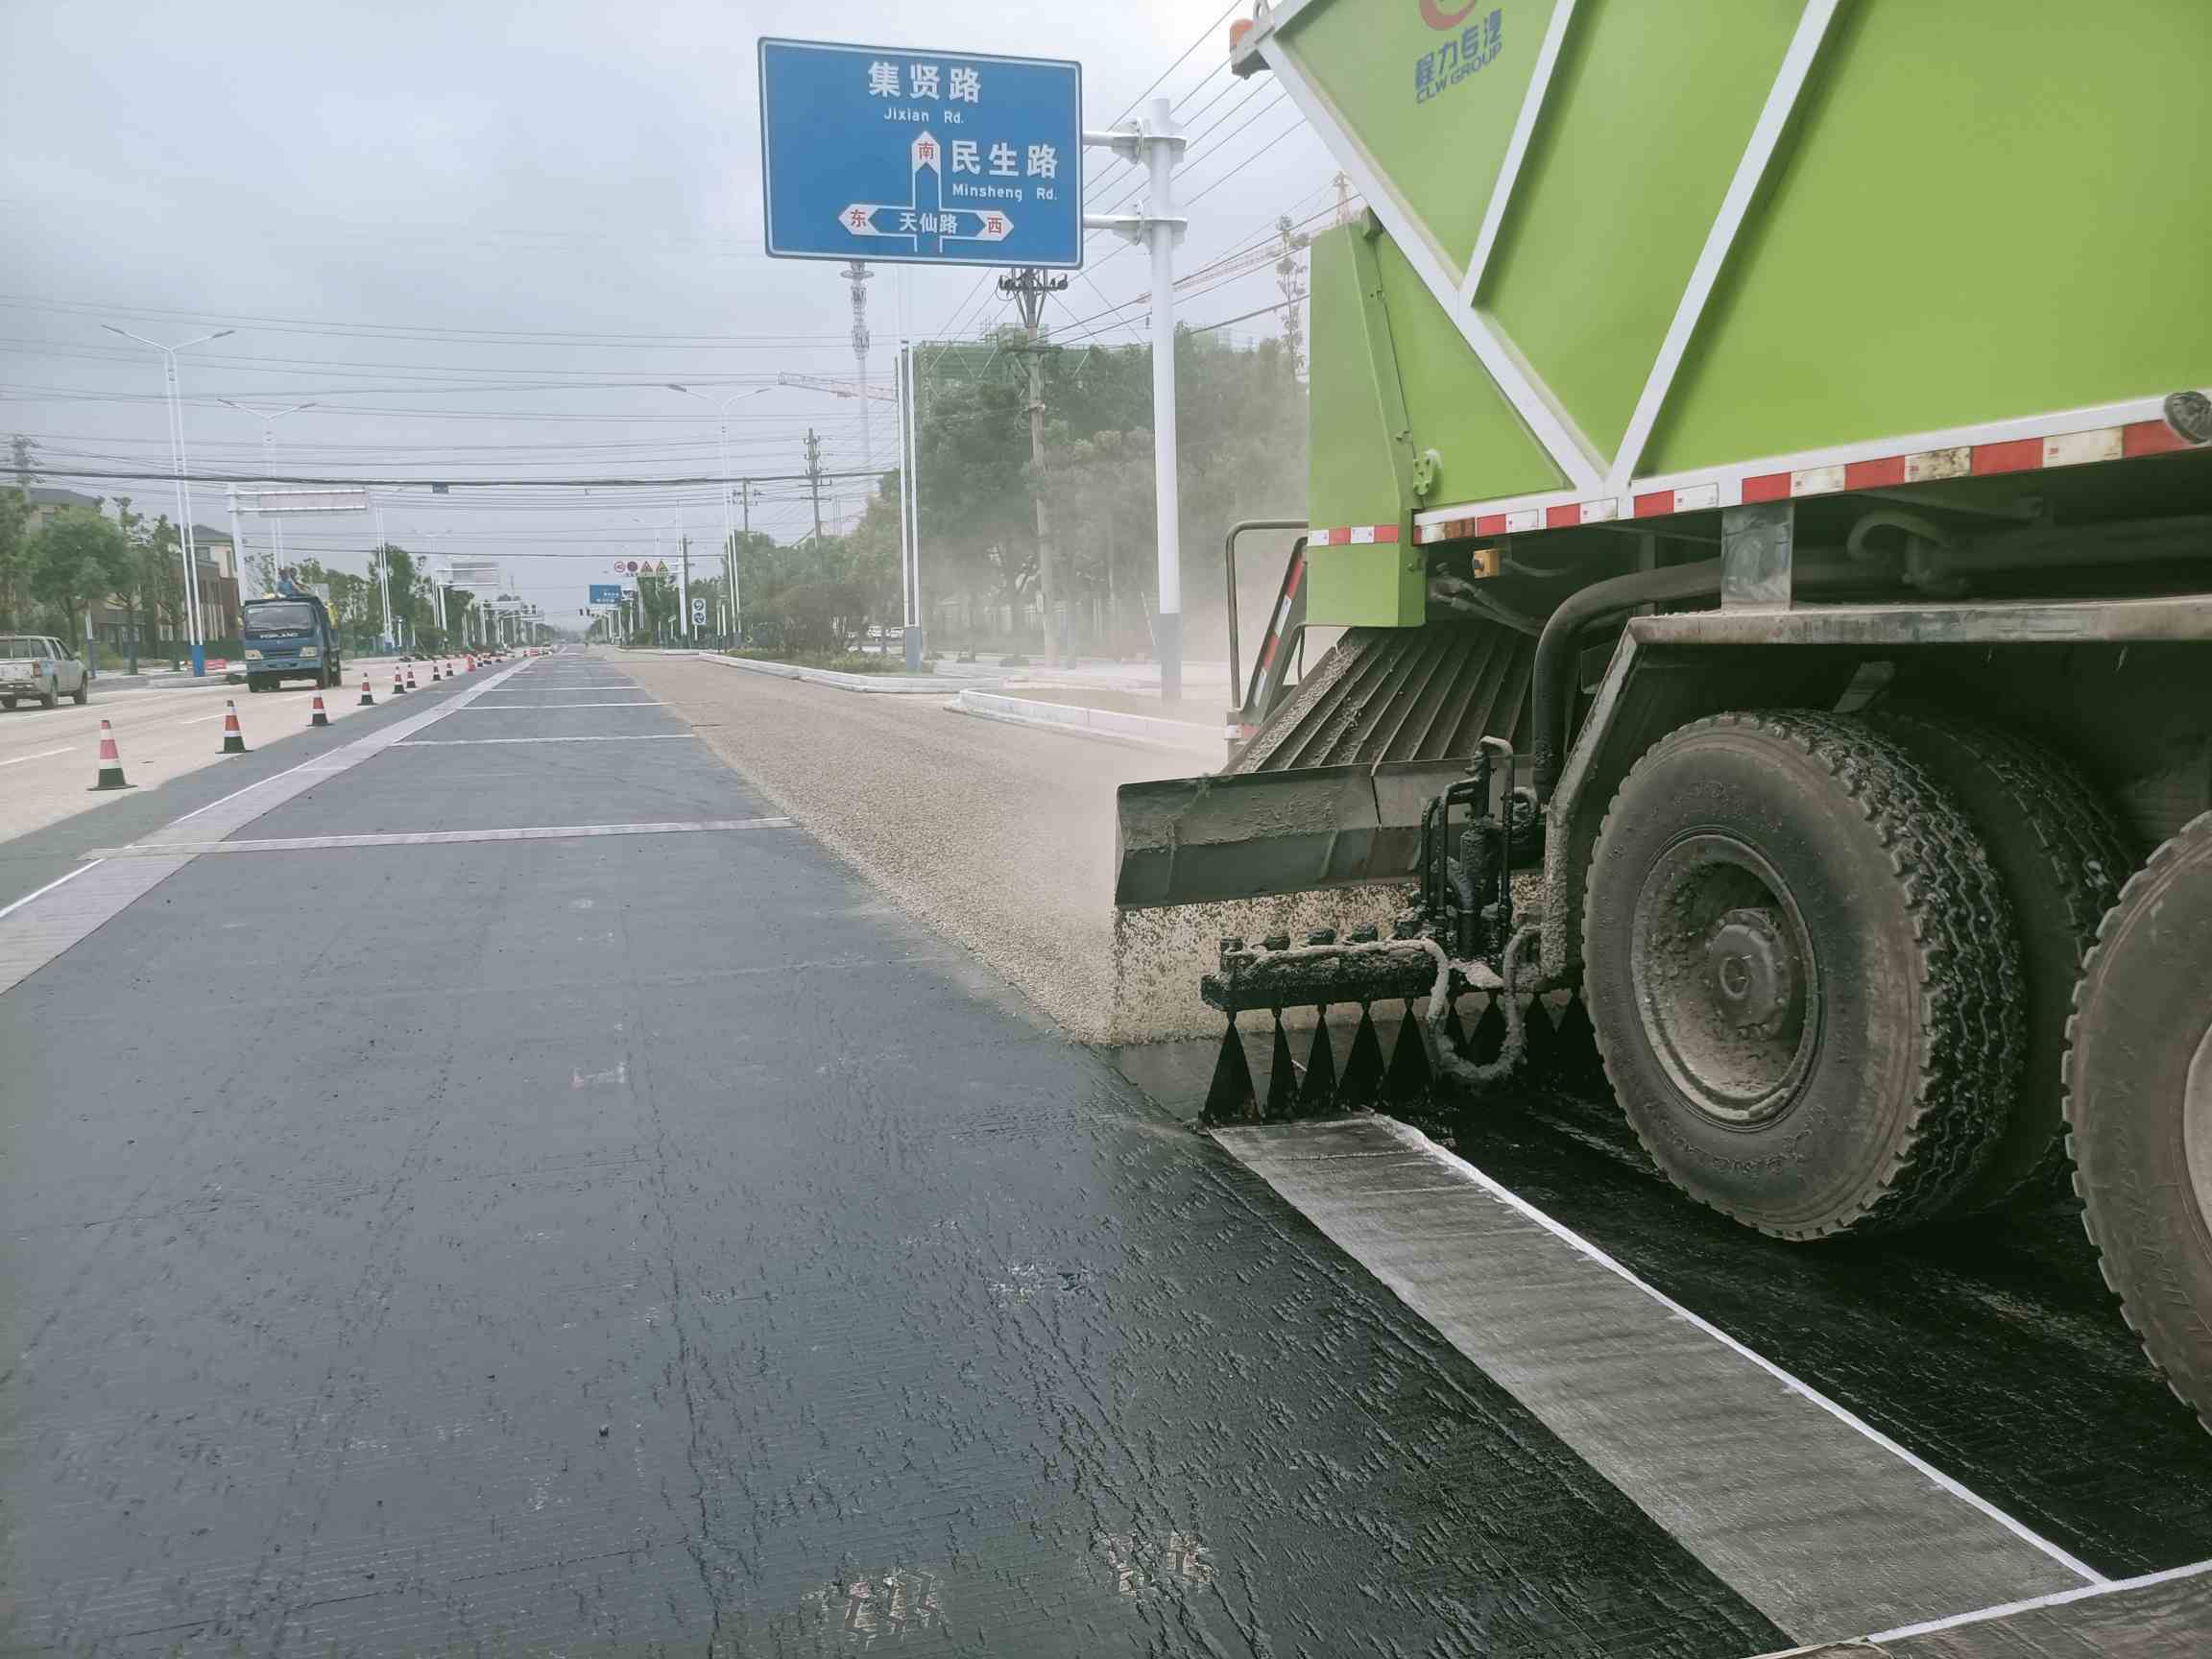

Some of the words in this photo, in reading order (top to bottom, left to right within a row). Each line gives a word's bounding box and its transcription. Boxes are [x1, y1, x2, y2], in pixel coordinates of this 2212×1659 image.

[868, 61, 981, 103] 集贤路
[1416, 76, 1447, 105] CLW
[1450, 42, 1503, 84] GROUP
[883, 107, 929, 123] Jixian
[944, 109, 964, 124] Rd.
[918, 142, 934, 159] 南
[951, 140, 1058, 179] 民生路
[952, 183, 1022, 202] Minsheng
[1037, 187, 1057, 201] Rd.
[851, 209, 867, 228] 东
[900, 212, 958, 234] 天仙路
[988, 216, 1002, 234] 西
